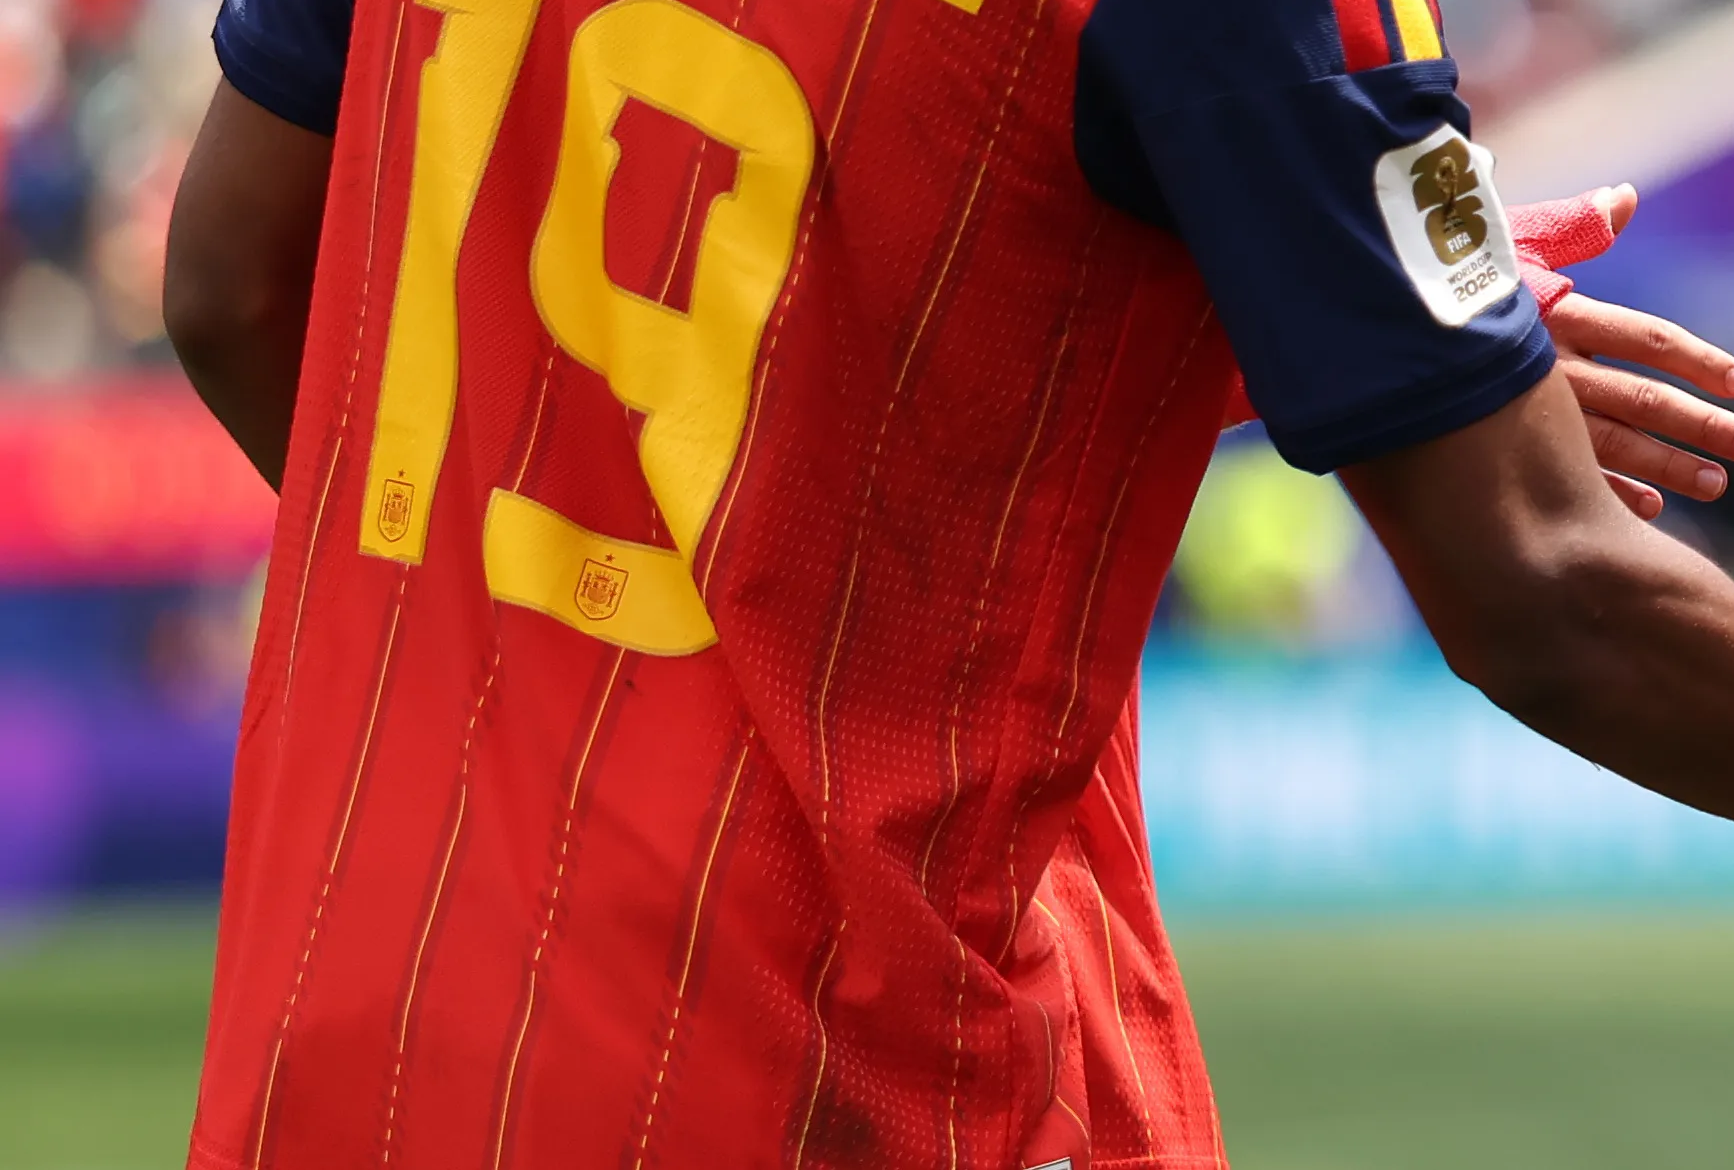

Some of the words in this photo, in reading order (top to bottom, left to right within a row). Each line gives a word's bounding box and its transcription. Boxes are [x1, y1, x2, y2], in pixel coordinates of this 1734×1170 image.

[1446, 232, 1472, 254] FIFA
[1447, 261, 1478, 285] WORLD
[1477, 251, 1493, 267] CUP
[1453, 265, 1499, 303] 2026
